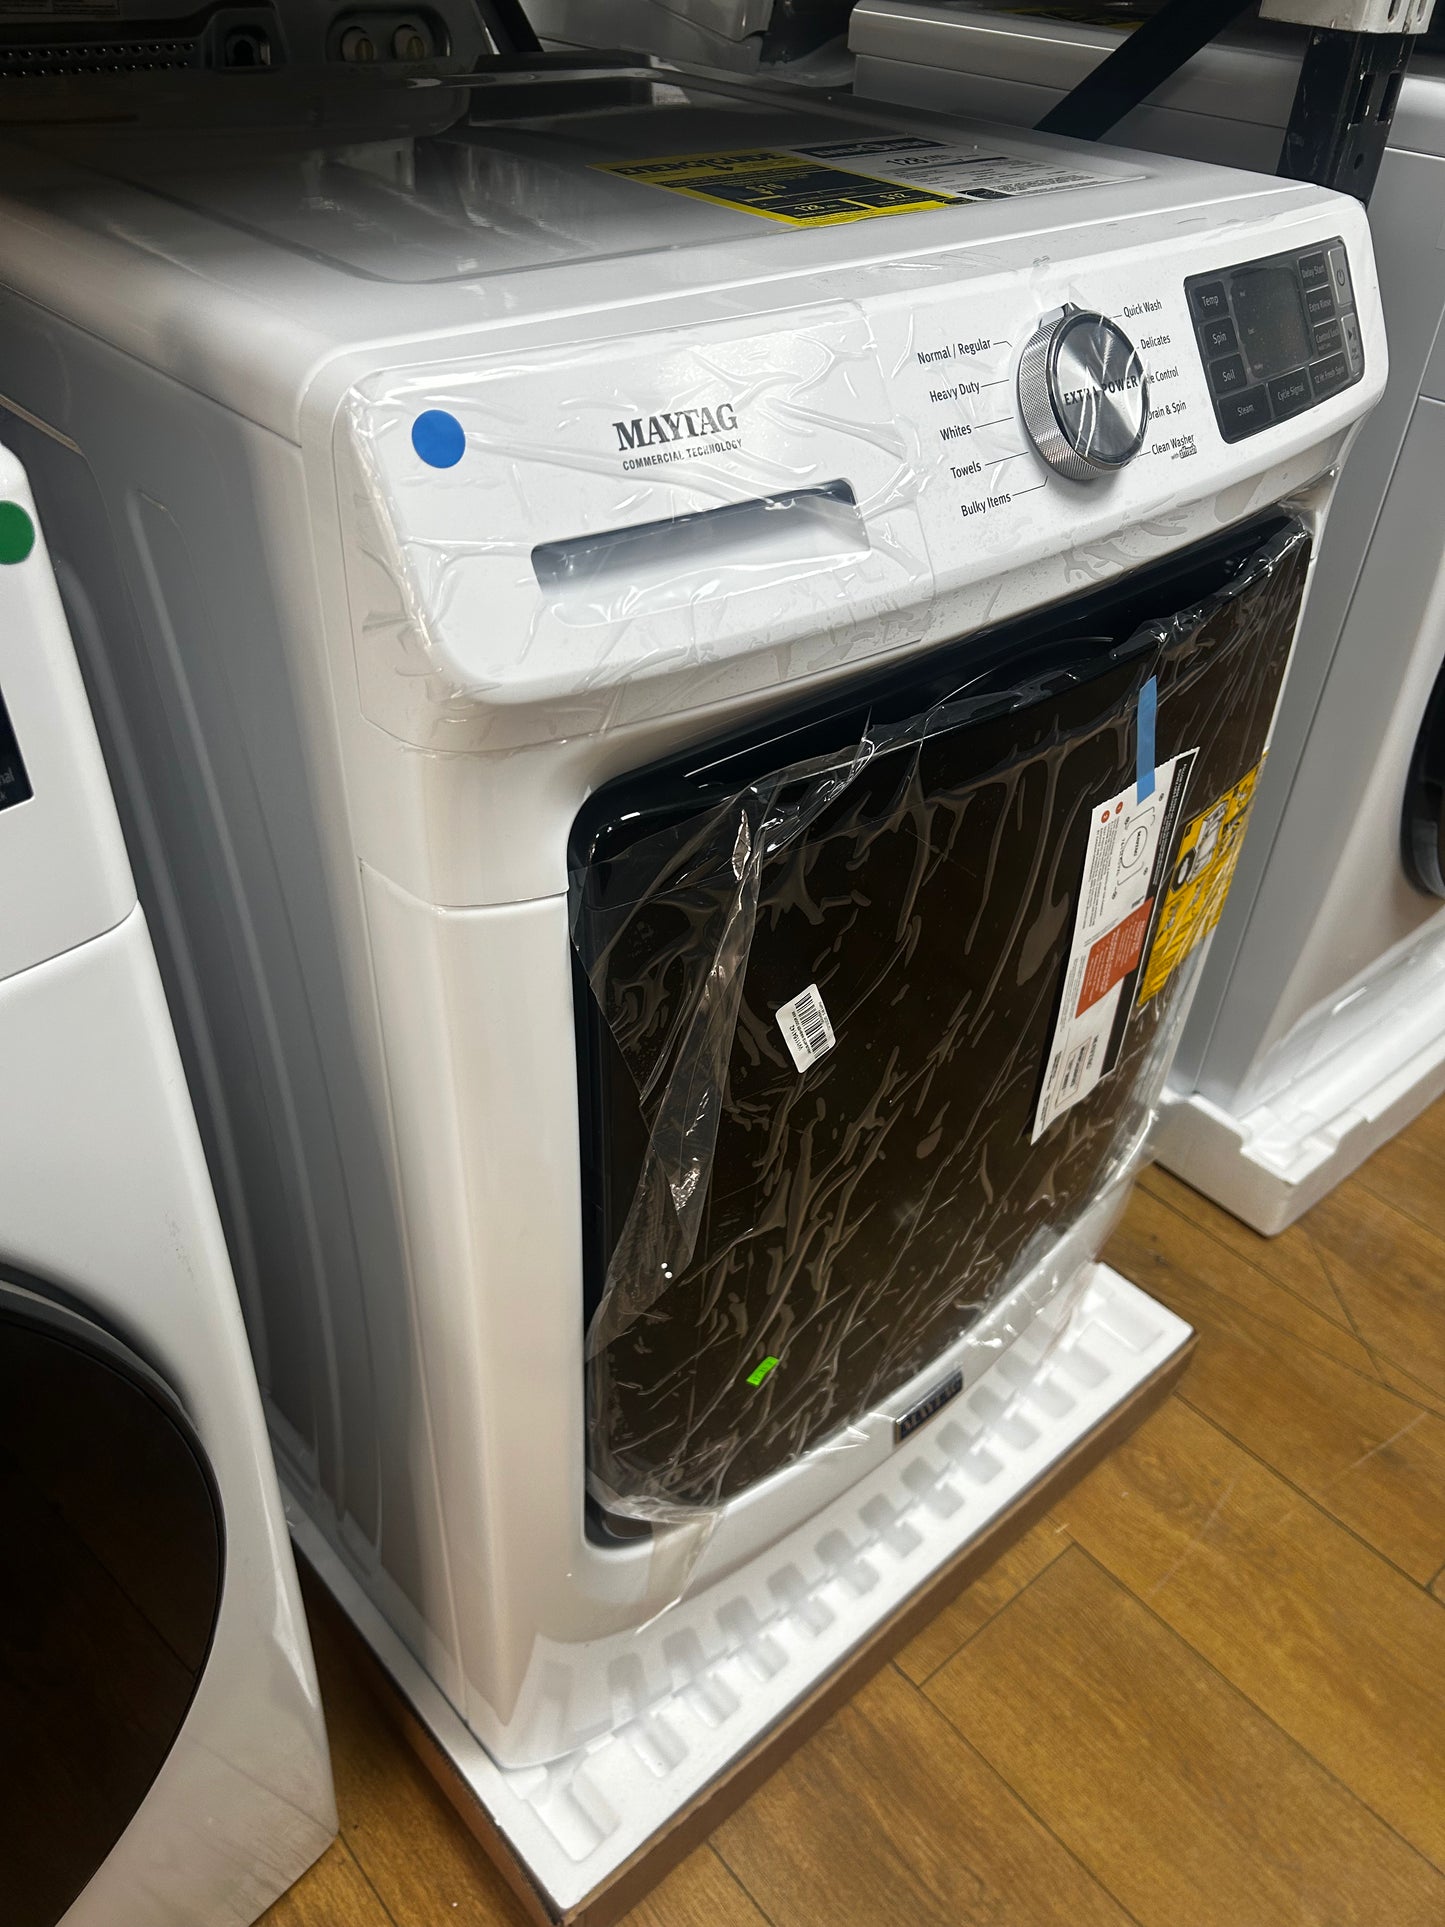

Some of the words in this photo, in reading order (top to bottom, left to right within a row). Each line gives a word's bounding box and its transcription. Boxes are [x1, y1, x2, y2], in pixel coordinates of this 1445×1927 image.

[885, 155, 929, 167] 128
[1123, 305, 1144, 318] Quick
[1144, 299, 1163, 314] Wash
[1202, 294, 1219, 307] Temp
[1140, 334, 1171, 350] Delicates
[1212, 331, 1227, 346] Spin
[917, 345, 952, 365] Normal
[957, 338, 991, 355] Regular
[1155, 366, 1179, 382] Control
[1222, 369, 1236, 383] Soil
[929, 386, 958, 403] Heavy
[958, 382, 980, 396] Duty
[1064, 386, 1098, 406] EXTRA
[1102, 375, 1139, 395] POWER
[1277, 389, 1290, 402] Cycle
[1165, 405, 1172, 415] &
[1171, 400, 1187, 415] Spin
[1237, 403, 1254, 417] Steam
[612, 403, 739, 451] MAYTAG
[940, 424, 972, 441] Whites
[1151, 440, 1171, 455] Clean
[1170, 434, 1195, 450] Washer
[622, 451, 685, 471] COMMERCIAL
[686, 438, 743, 460] TECHNOLOGY
[950, 461, 982, 479] Towels
[960, 500, 986, 517] Bulky
[986, 493, 1012, 509] Items
